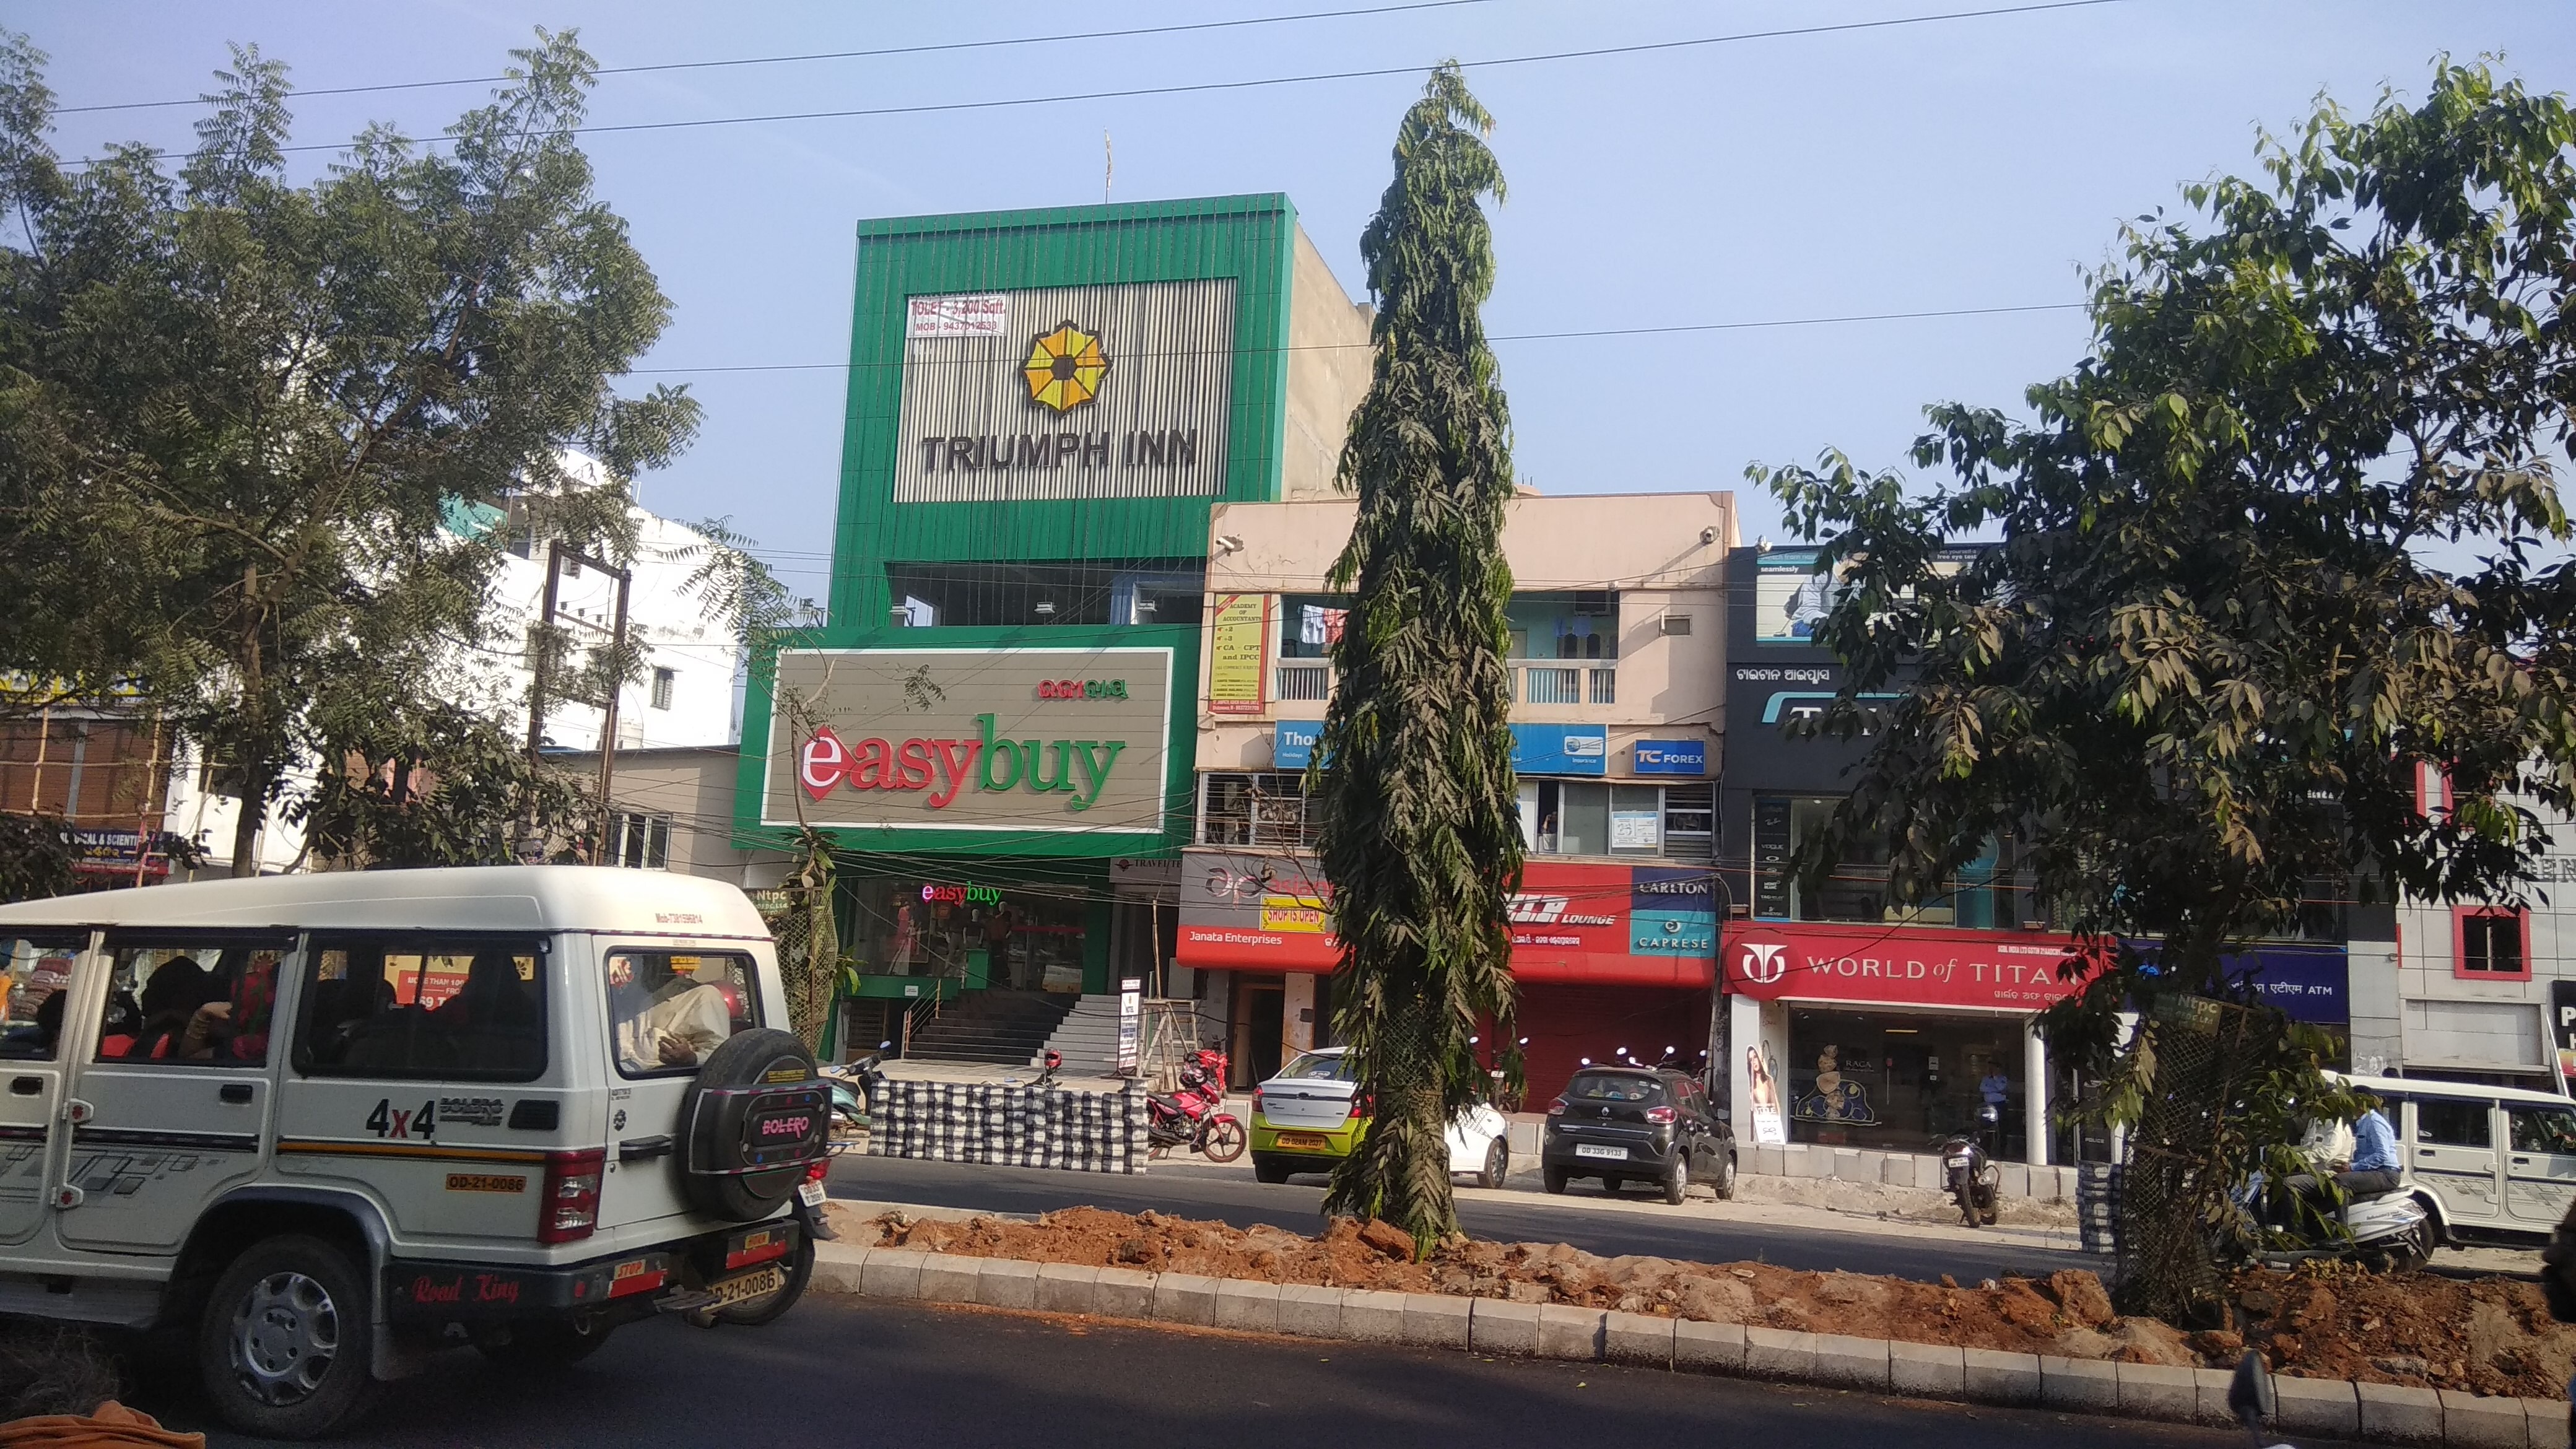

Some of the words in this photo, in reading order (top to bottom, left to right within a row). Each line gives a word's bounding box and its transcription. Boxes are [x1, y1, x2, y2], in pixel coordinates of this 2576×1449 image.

[911, 301, 944, 316] TOLET
[952, 299, 980, 318] 3,200
[916, 323, 936, 331] MOB
[943, 321, 997, 331] 9437012533
[921, 431, 1111, 471] TRIUMPH
[1125, 429, 1198, 466] INN
[1760, 565, 1799, 573] seamlessly
[1284, 731, 1317, 746] Tho
[801, 713, 1127, 811] easybuy
[1637, 749, 1663, 764] TC
[1664, 754, 1703, 764] FOREX
[1639, 877, 1708, 894] CARLTON
[757, 890, 787, 903] Ntpc
[922, 881, 1003, 907] easybuy
[1268, 910, 1288, 922] SHOP
[1290, 910, 1297, 922] IS
[1300, 910, 1320, 923] OPEN
[1561, 915, 1617, 925] LOUNGE
[1190, 931, 1223, 941] Janata
[1225, 933, 1282, 946] Enterprises
[1639, 937, 1708, 949] CAPRESE
[1807, 956, 1925, 980] WORLD
[1933, 958, 1958, 983] of
[2269, 981, 2302, 994] एटीएम
[2307, 985, 2333, 996] ATM
[2178, 994, 2219, 1014] Ntpc
[762, 1116, 809, 1139] BOLERO
[450, 1176, 524, 1190] OD-21-0086
